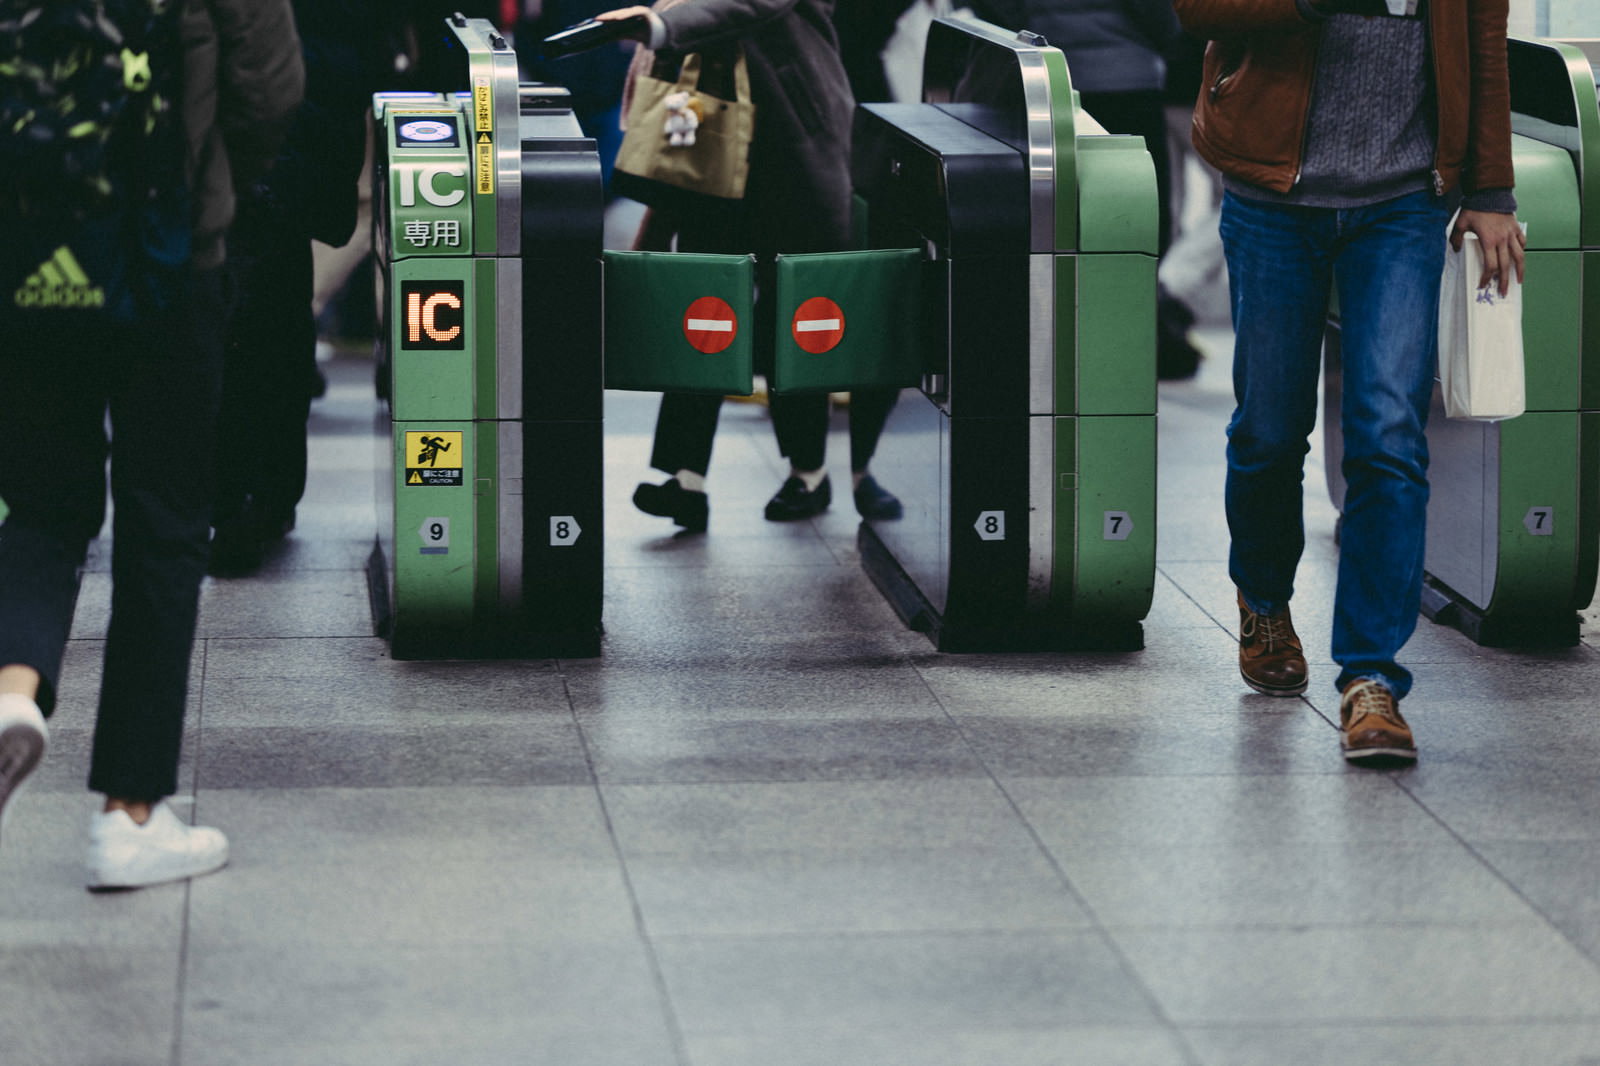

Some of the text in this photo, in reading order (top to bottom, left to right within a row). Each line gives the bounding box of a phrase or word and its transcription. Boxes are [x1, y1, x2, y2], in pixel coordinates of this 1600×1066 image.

[401, 168, 465, 206] IC
[403, 220, 460, 247] 専用
[14, 285, 105, 307] adidas
[408, 293, 460, 341] IC
[984, 516, 999, 534] 8
[1109, 516, 1124, 534] 7
[1533, 511, 1547, 529] 7
[429, 523, 444, 541] 9
[555, 521, 570, 539] 8
